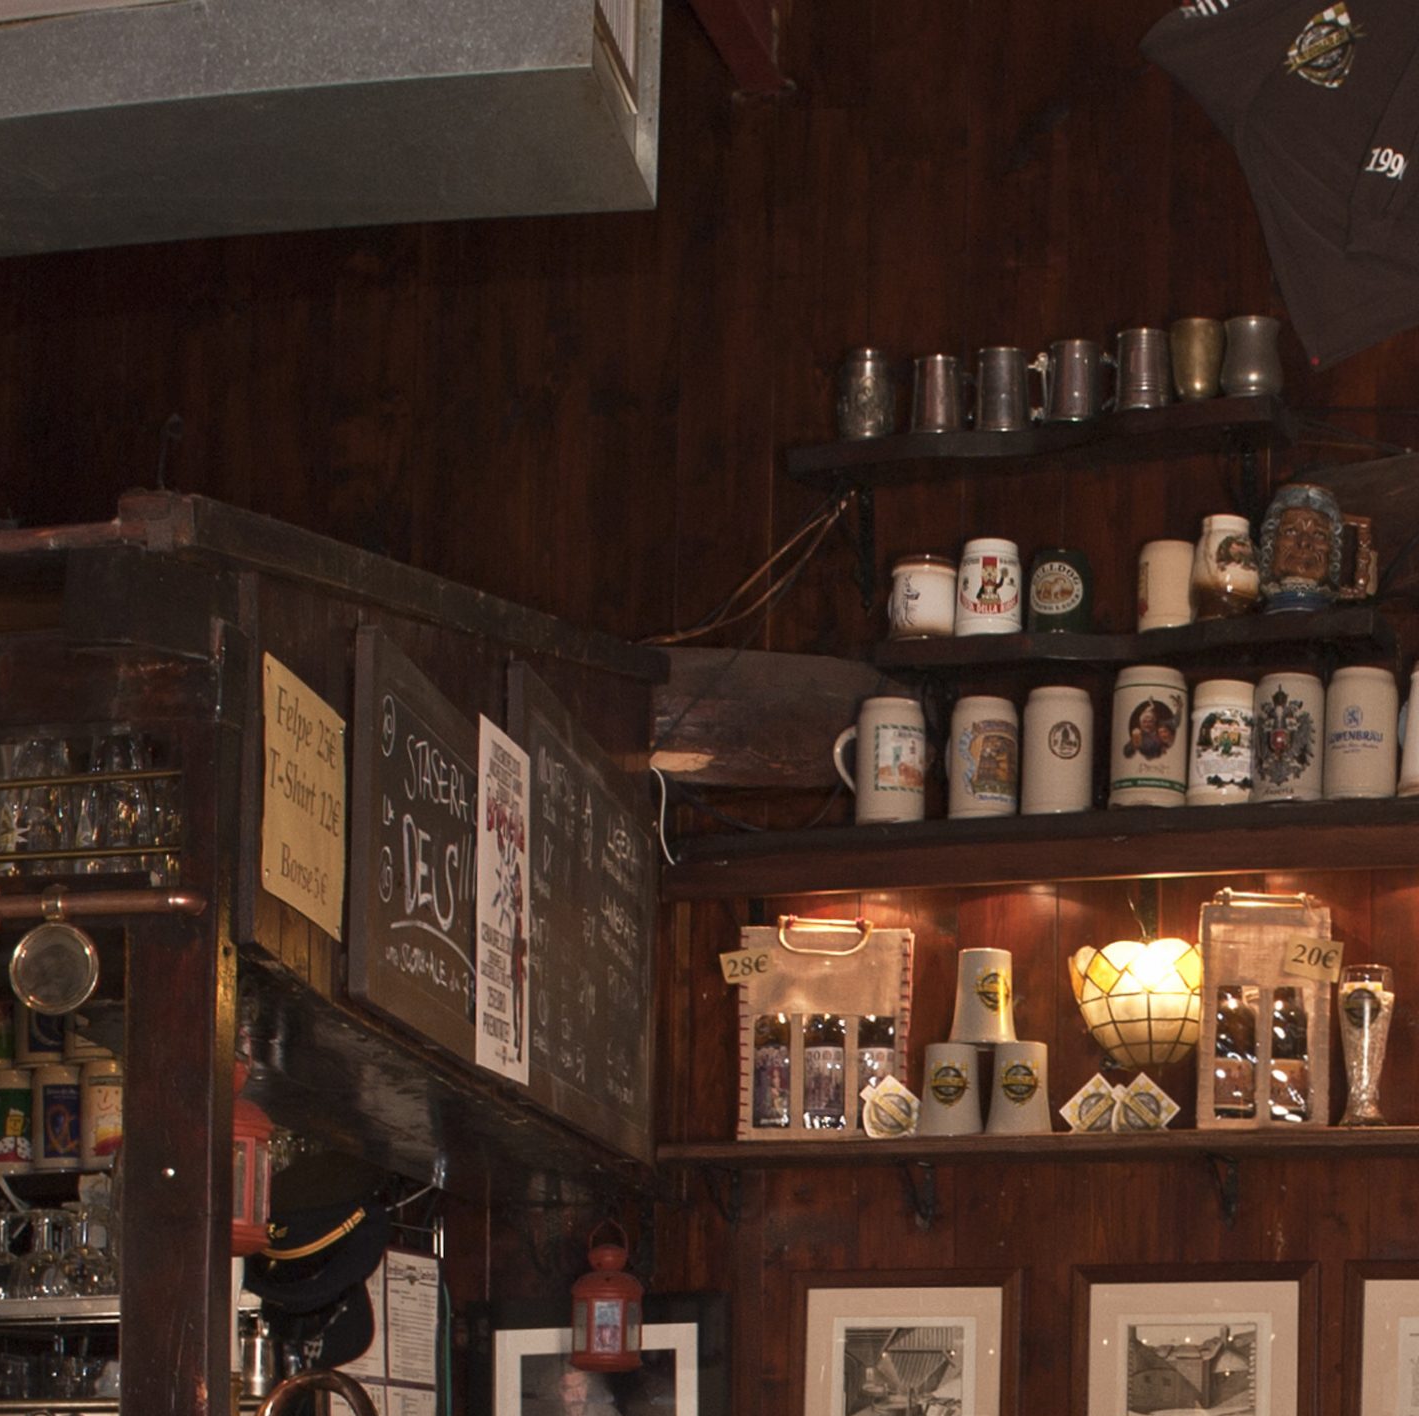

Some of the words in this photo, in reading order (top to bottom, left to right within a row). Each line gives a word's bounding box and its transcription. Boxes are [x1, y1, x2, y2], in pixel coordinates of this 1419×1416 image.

[276, 684, 313, 753] Felpe
[269, 746, 317, 817] T-Shirt
[280, 842, 313, 895] Borse
[727, 954, 769, 978] 28€
[1292, 944, 1339, 969] 20€
